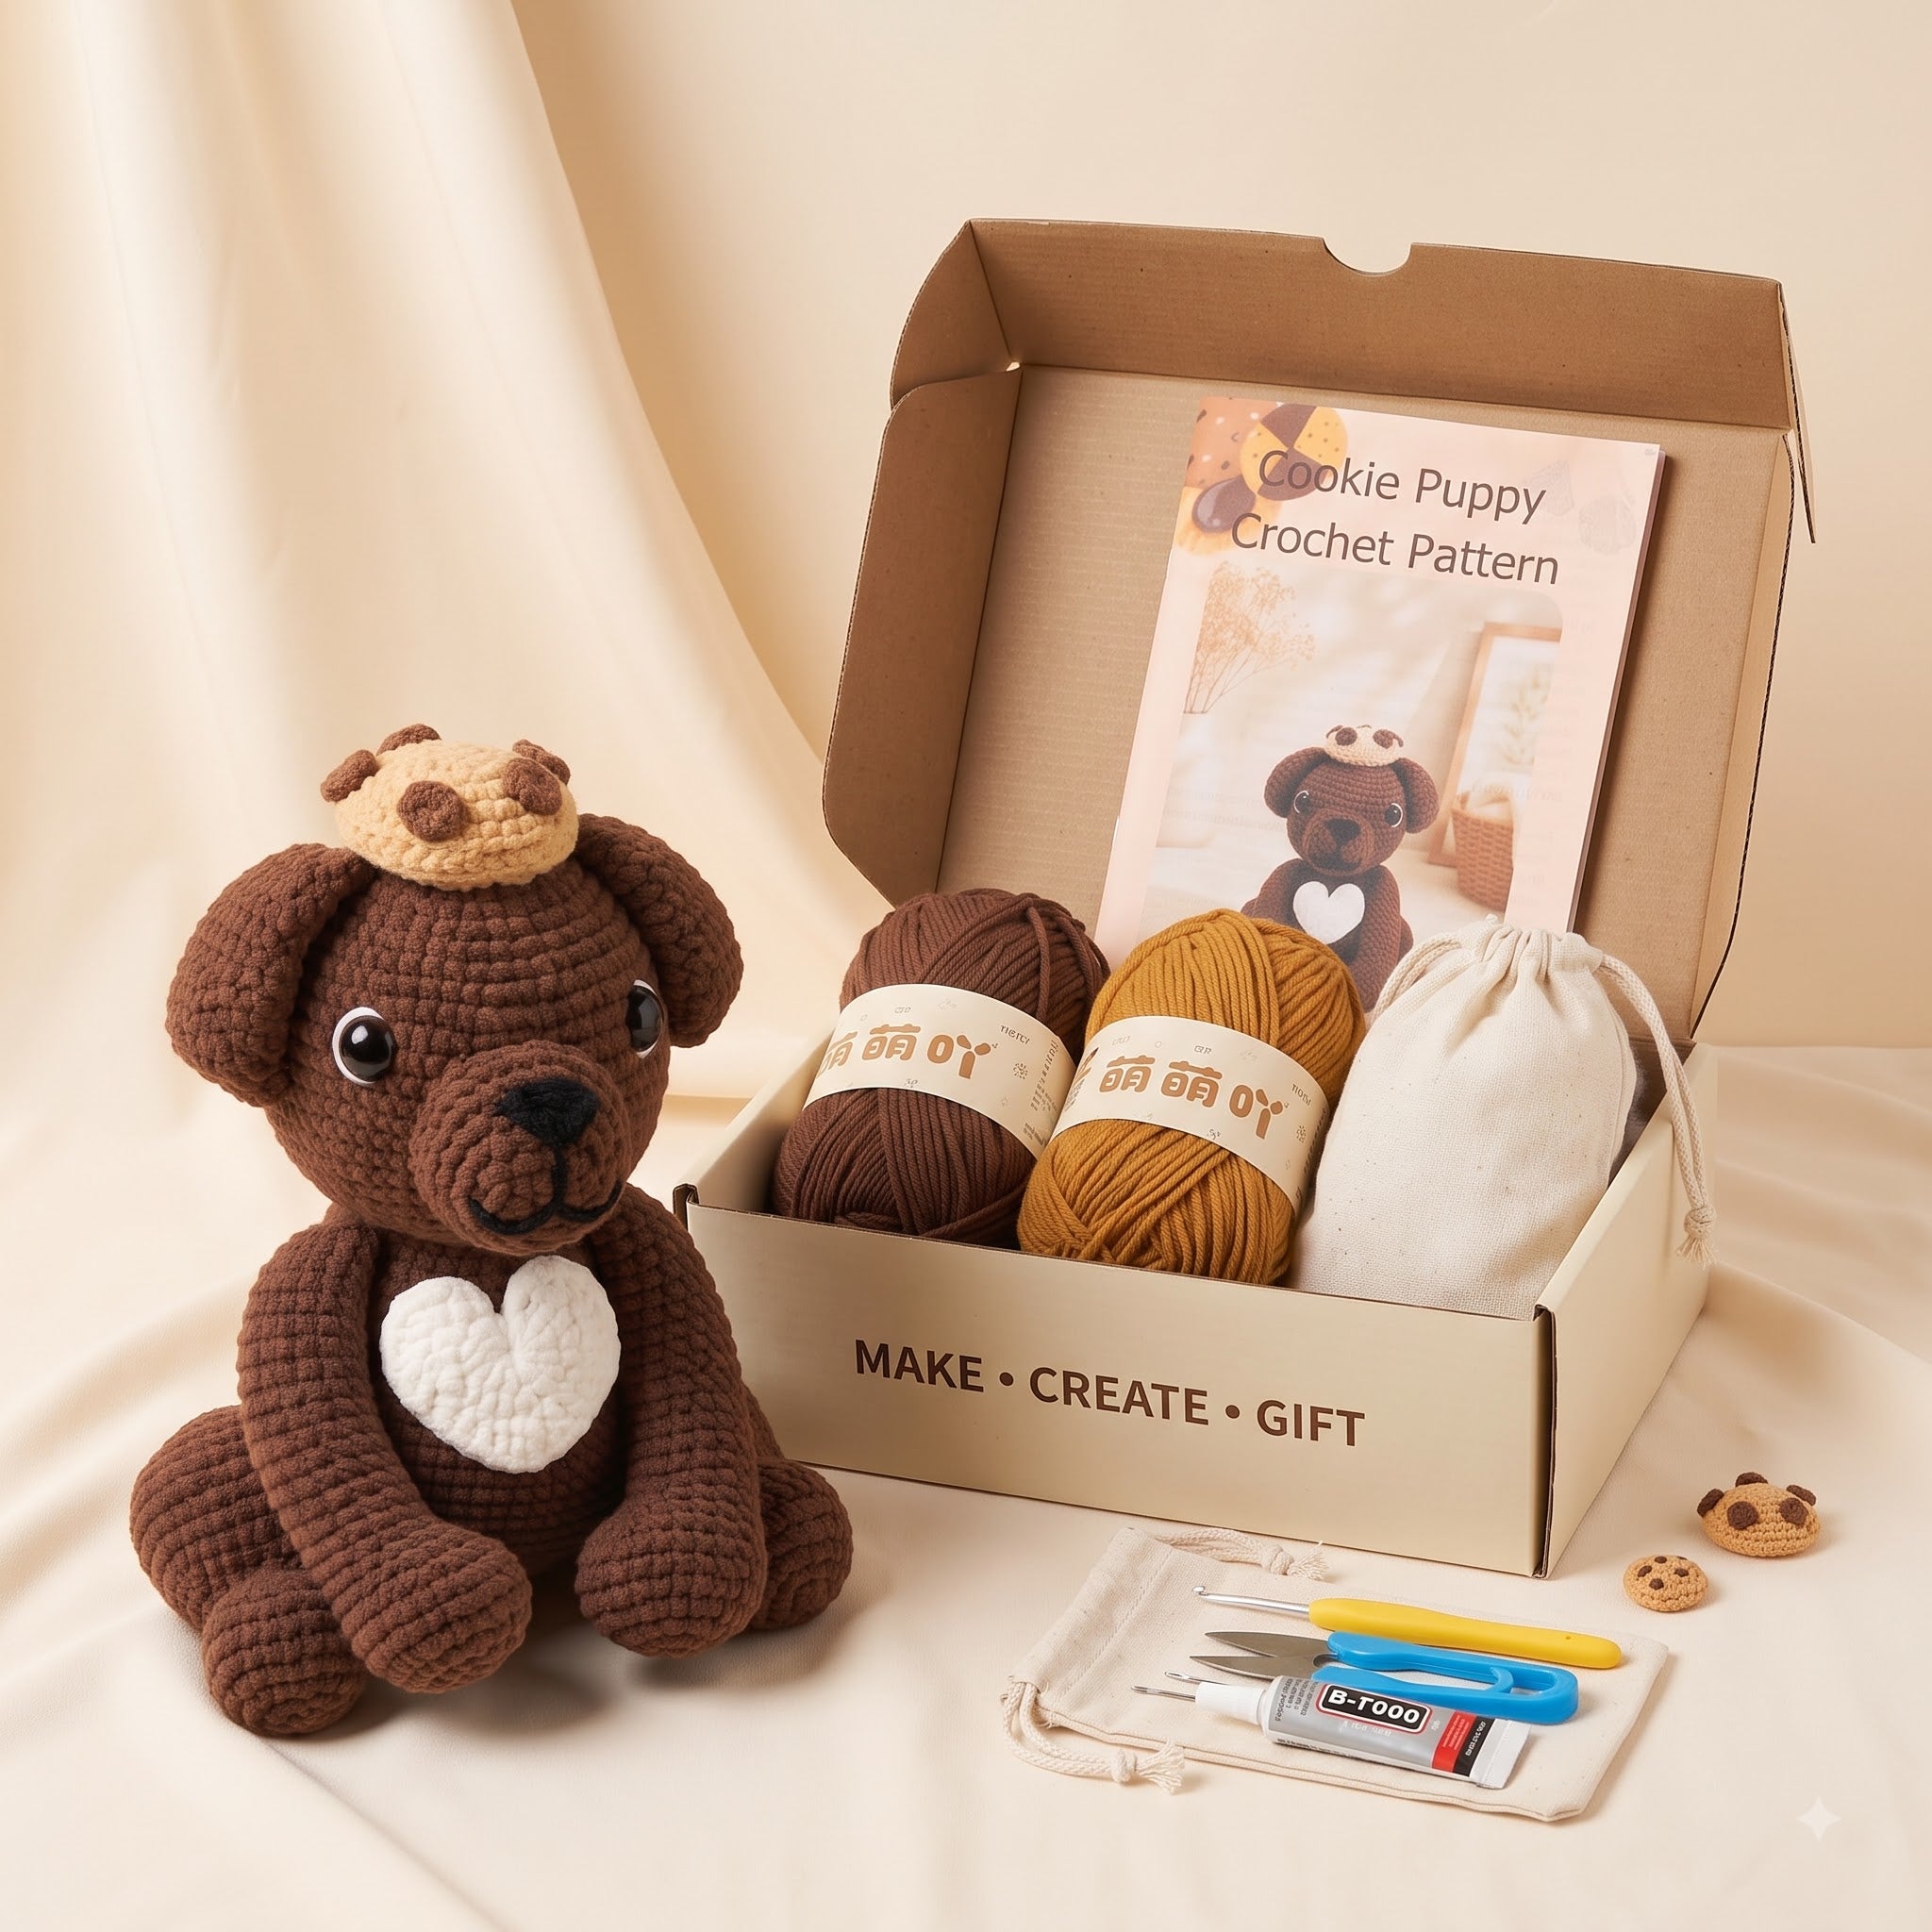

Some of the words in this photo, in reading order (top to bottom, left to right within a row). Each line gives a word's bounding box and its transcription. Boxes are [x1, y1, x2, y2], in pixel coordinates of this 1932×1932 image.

[1257, 449, 1401, 501] Cookie
[1414, 466, 1547, 525] Puppy
[1230, 512, 1395, 567] Crochet
[1407, 532, 1560, 586] Pattern
[855, 1338, 985, 1392] MAKE
[1029, 1366, 1209, 1426] CREATE
[1257, 1399, 1366, 1447] GIFT
